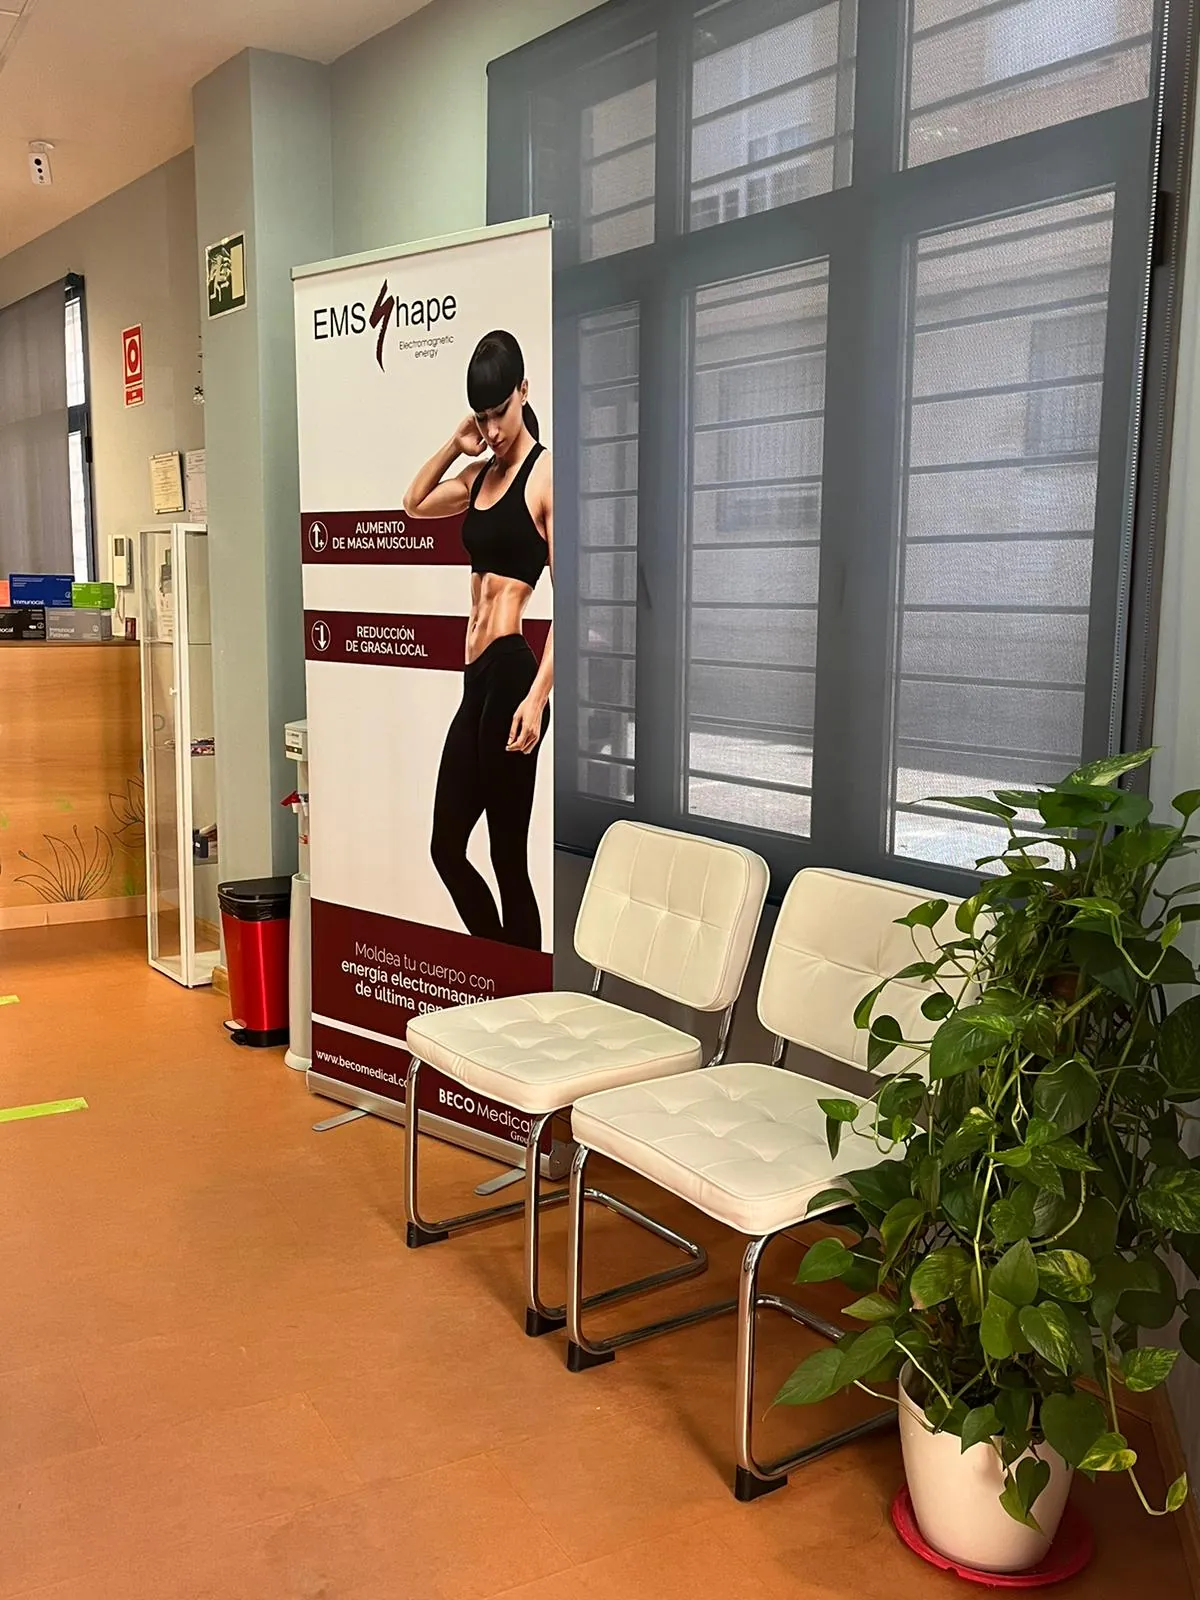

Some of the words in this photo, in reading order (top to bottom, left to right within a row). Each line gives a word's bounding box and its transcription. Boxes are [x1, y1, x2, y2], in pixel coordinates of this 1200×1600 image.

[314, 302, 366, 340] EMS
[399, 335, 454, 350] Electromagnetic
[414, 349, 438, 358] energy
[355, 521, 405, 534] AUMENTO
[332, 537, 345, 550] DE
[347, 537, 375, 549] MASA
[377, 536, 434, 549] MUSCULAR
[356, 625, 415, 641] REDUCCIÓN
[345, 640, 358, 652] DE
[360, 641, 393, 655] GRASA
[395, 643, 428, 657] LOCAL
[341, 960, 388, 984] energía
[355, 941, 400, 967] Moldea
[404, 954, 417, 971] tu
[419, 961, 466, 984] cuerpo
[469, 974, 495, 992] con
[355, 980, 372, 997] de
[374, 985, 415, 1011] última
[315, 1050, 408, 1088] www.becomedical.co
[439, 1088, 475, 1113] BECO
[510, 1130, 529, 1144] Grou
